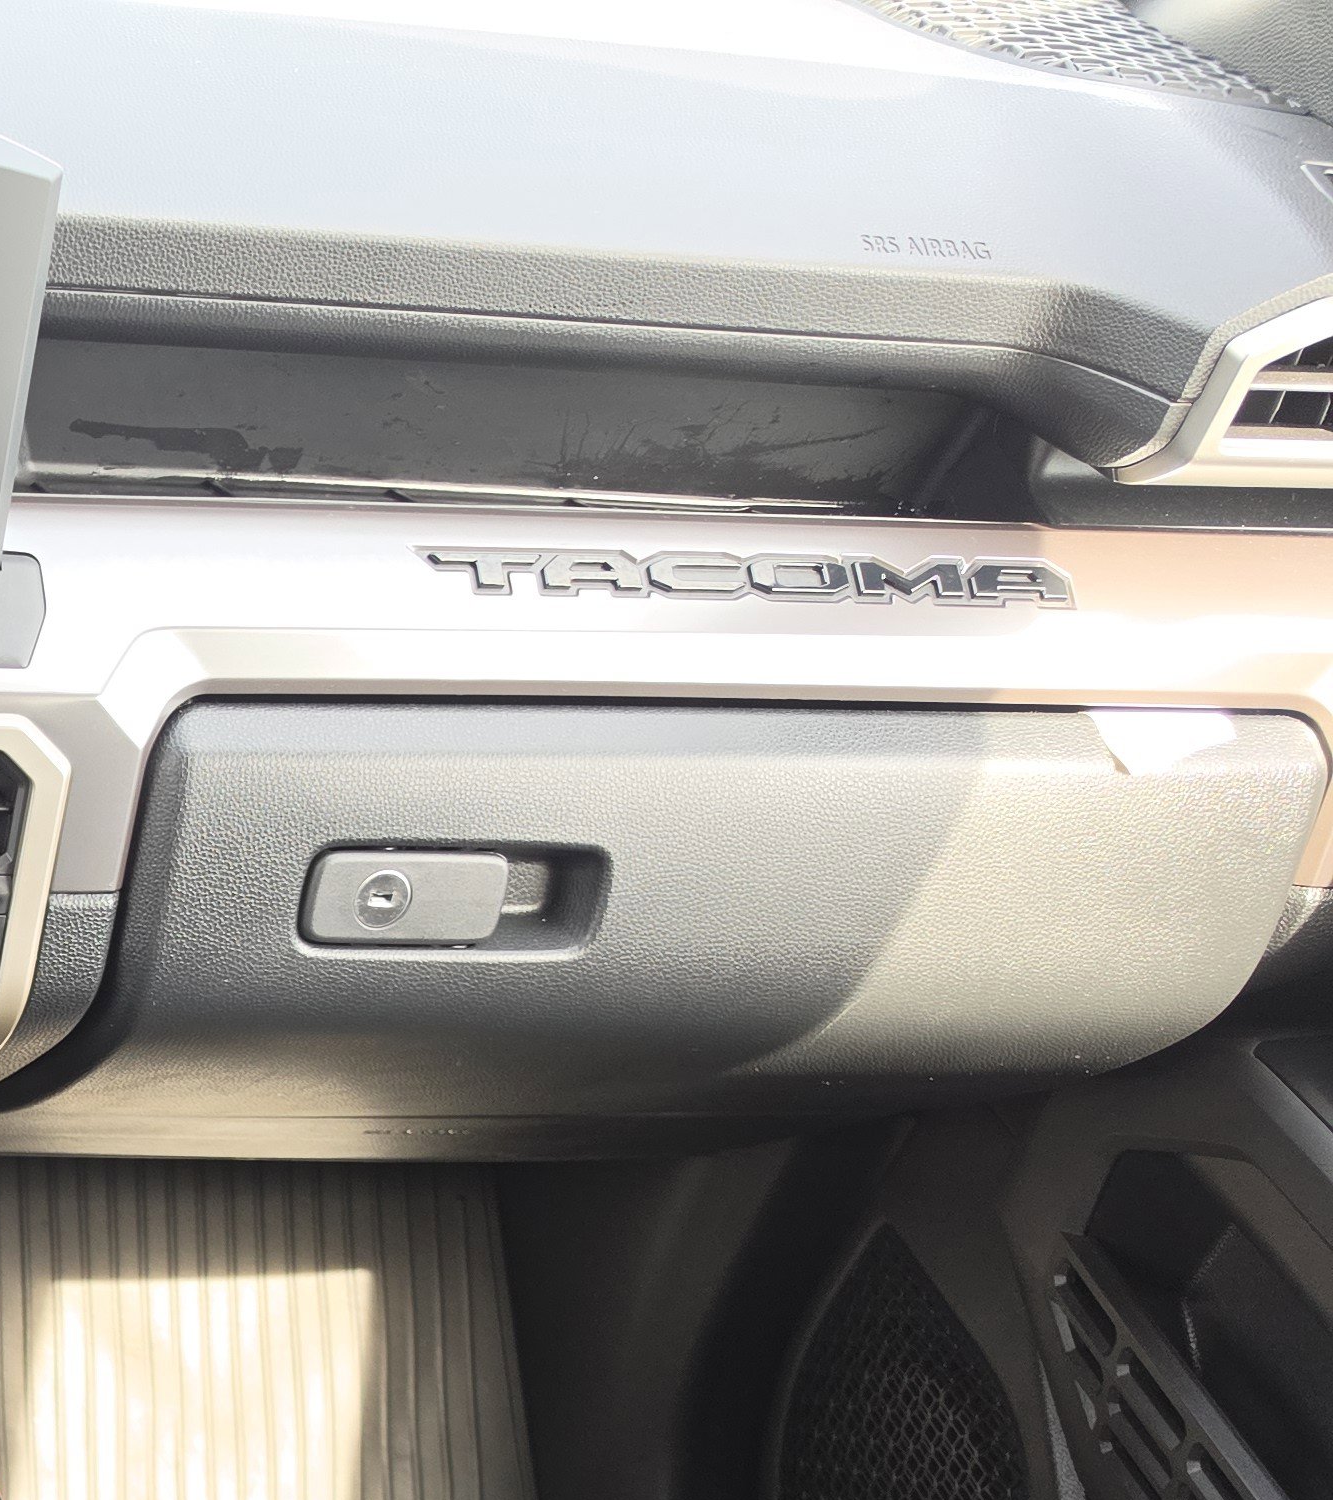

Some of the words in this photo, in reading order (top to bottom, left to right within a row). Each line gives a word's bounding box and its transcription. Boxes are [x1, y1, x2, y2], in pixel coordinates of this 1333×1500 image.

[860, 234, 901, 253] SRS
[907, 236, 992, 260] AIRBAG
[407, 545, 1077, 611] TACOMA
